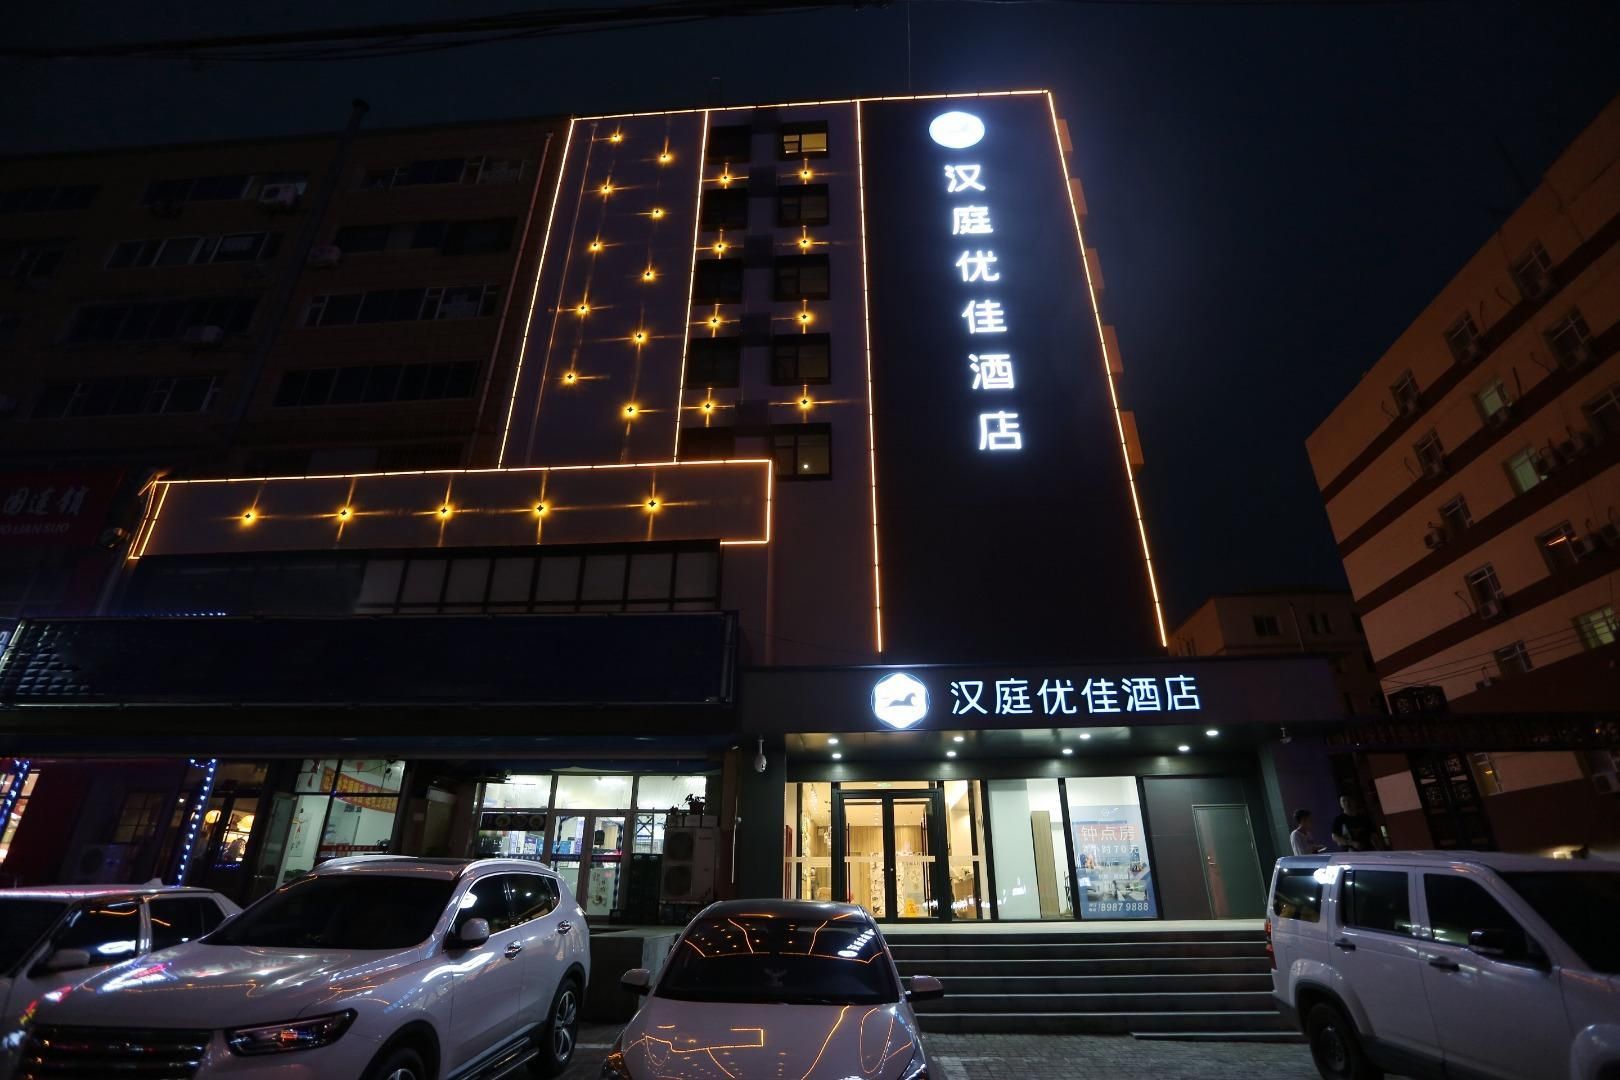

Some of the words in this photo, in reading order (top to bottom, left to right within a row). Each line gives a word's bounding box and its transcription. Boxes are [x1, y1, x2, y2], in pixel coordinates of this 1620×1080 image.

[944, 163, 1023, 452] 汉庭优佳酒店
[950, 674, 1201, 715] 汉庭优佳酒店
[1081, 825, 1137, 841] 钟点房
[1100, 902, 1123, 912] 8987
[1125, 902, 1149, 911] 9888
